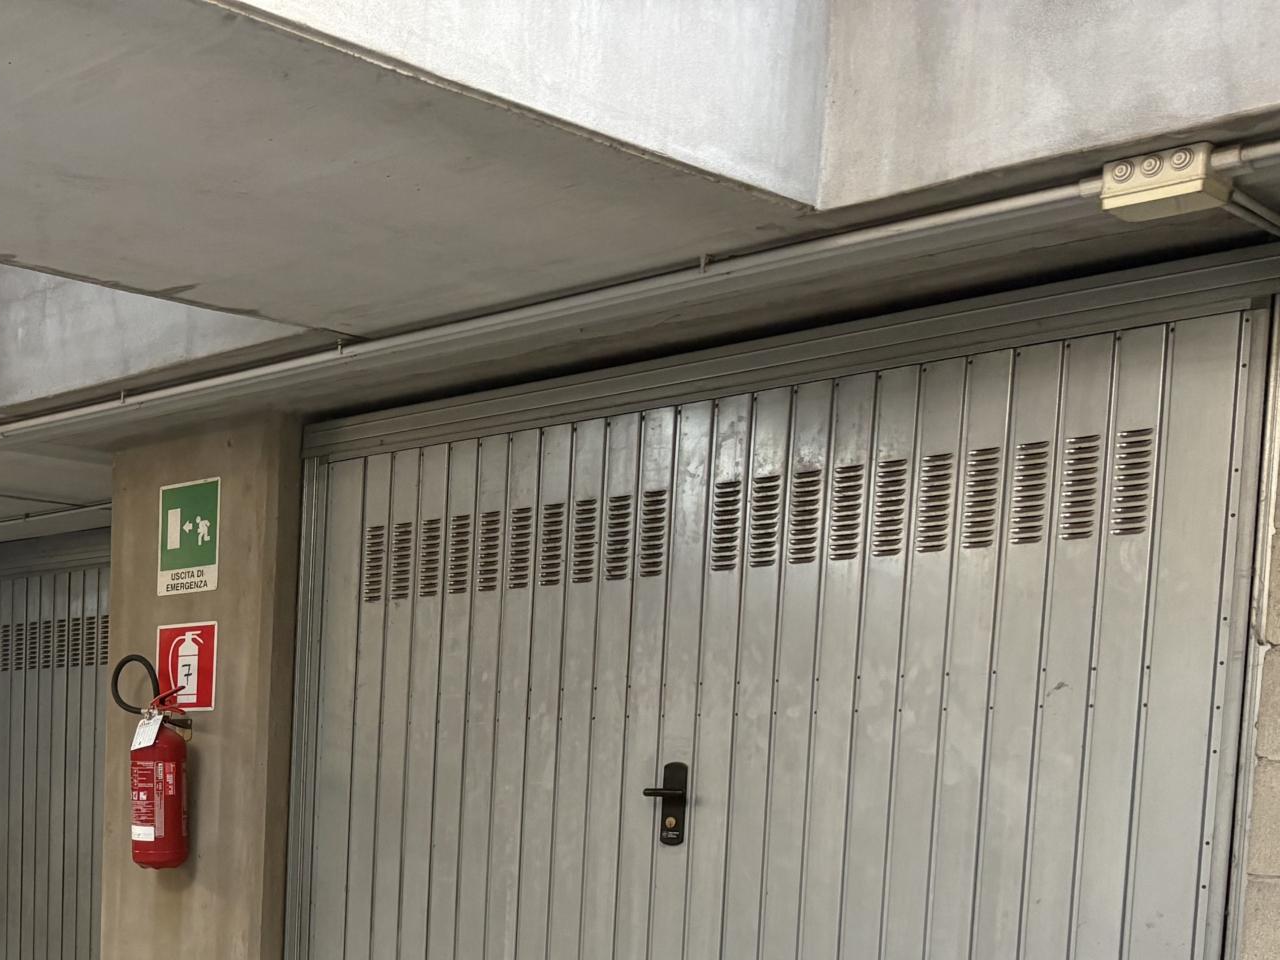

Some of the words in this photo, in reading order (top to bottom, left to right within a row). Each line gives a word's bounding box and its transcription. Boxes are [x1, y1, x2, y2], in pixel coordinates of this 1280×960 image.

[171, 570, 195, 581] USCITA
[197, 569, 204, 577] DI
[166, 580, 207, 591] EMERGENZA
[182, 664, 193, 686] 7
